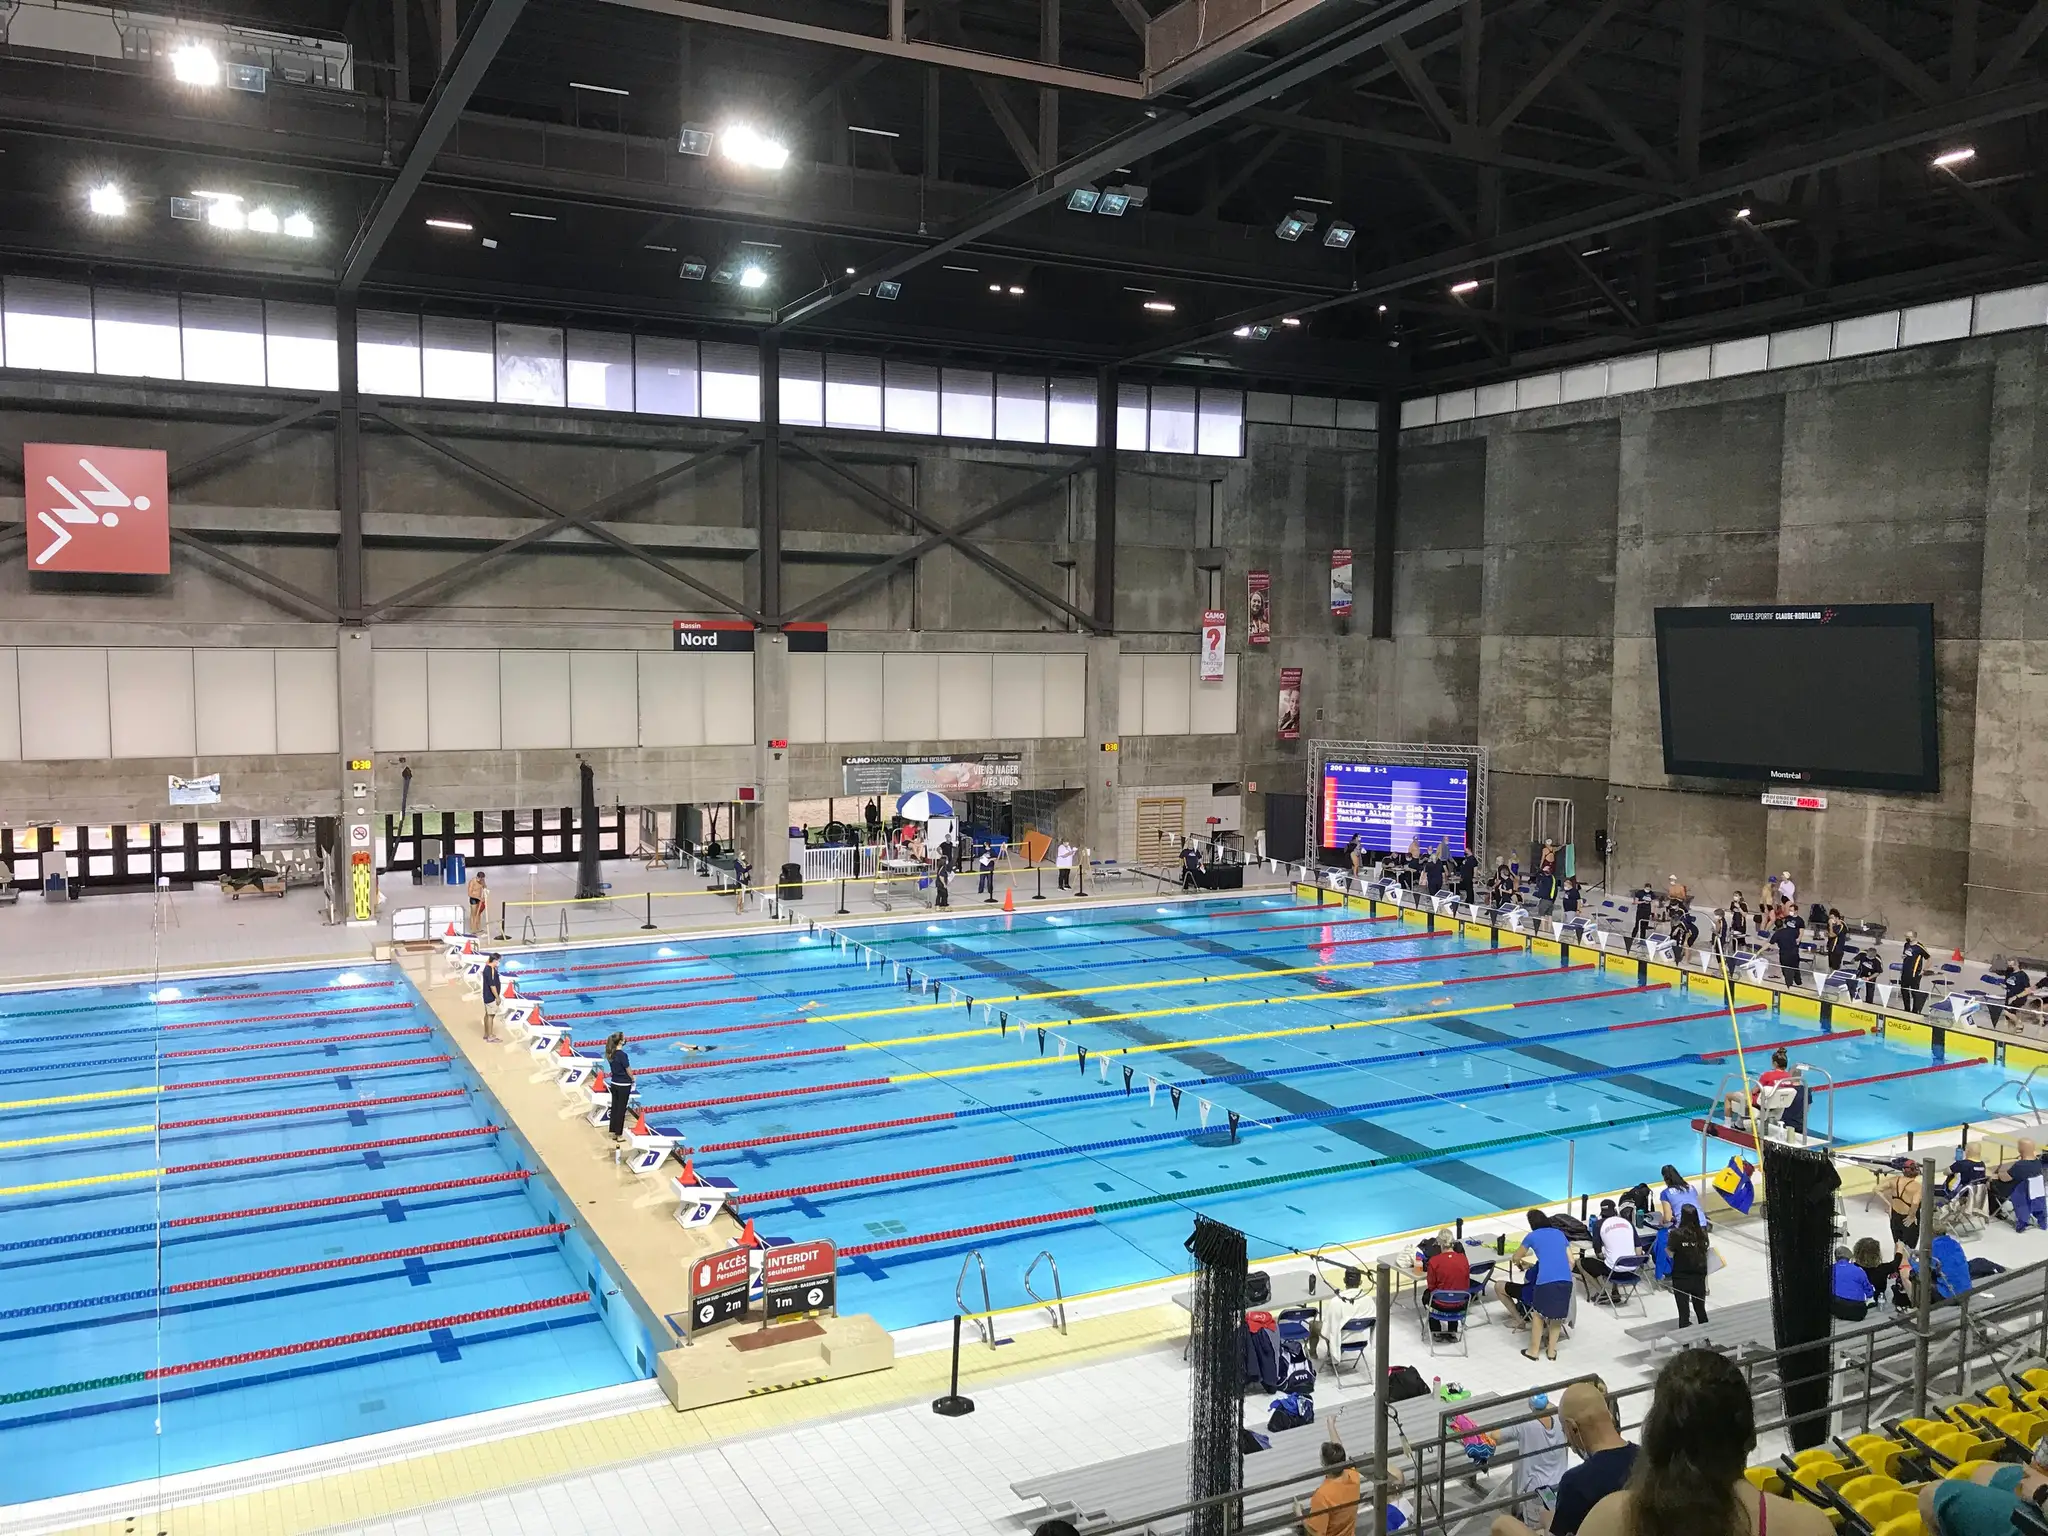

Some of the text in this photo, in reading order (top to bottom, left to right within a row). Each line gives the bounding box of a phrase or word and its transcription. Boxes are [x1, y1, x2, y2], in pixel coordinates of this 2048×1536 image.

[1730, 612, 1821, 620] COMPLEXE SPORTIF CLAUDE-ROBILLARD
[680, 632, 717, 646] Nord
[973, 764, 1018, 775] VIENS NAGER
[1770, 770, 1801, 779] Montréal
[981, 776, 1018, 786] AVEC NOUS
[1607, 957, 1624, 965] OMEGA
[1689, 975, 1709, 984] OMEGA
[1849, 1012, 1874, 1023] OMEGA
[1887, 1021, 1912, 1031] OMEGA
[571, 1071, 578, 1081] 5
[649, 1153, 655, 1163] 7
[699, 1206, 706, 1217] 8
[716, 1254, 747, 1273] ACCÈS
[767, 1249, 819, 1268] INTERDIT
[716, 1266, 747, 1281] Personnel
[767, 1264, 806, 1277] seulement
[767, 1284, 798, 1294] PROFONDEUR
[696, 1297, 711, 1305] BASSIN
[721, 1285, 746, 1298] PROFONDEUR
[775, 1297, 793, 1308] 1m
